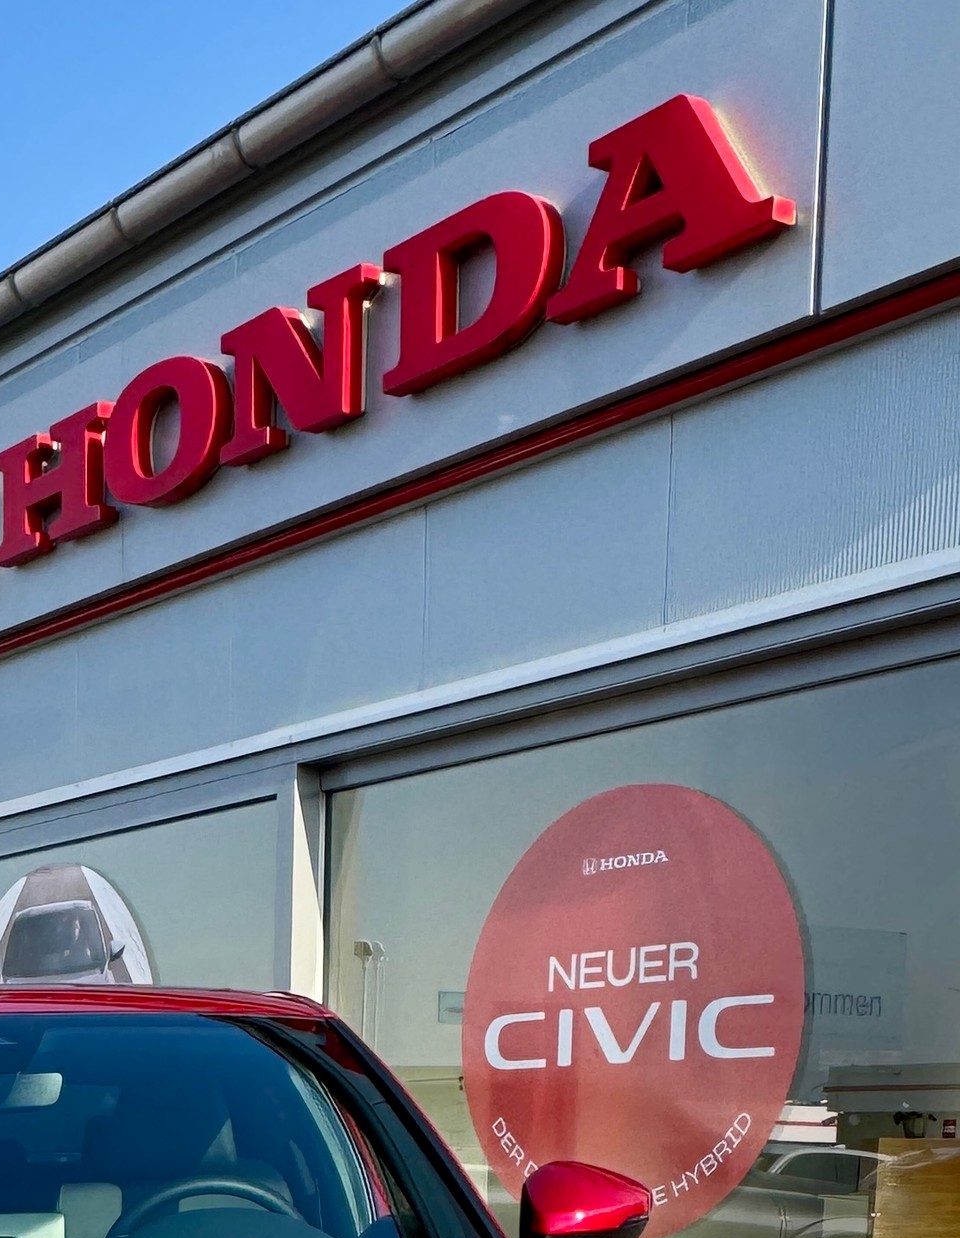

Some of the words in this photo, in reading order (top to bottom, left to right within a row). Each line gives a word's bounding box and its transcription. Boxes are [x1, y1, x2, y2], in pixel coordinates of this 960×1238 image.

[600, 849, 669, 871] HONDA
[548, 941, 699, 993] NEUER
[484, 994, 776, 1071] CIVIC
[492, 1116, 525, 1167] DER
[671, 1112, 752, 1197] HYBRID
